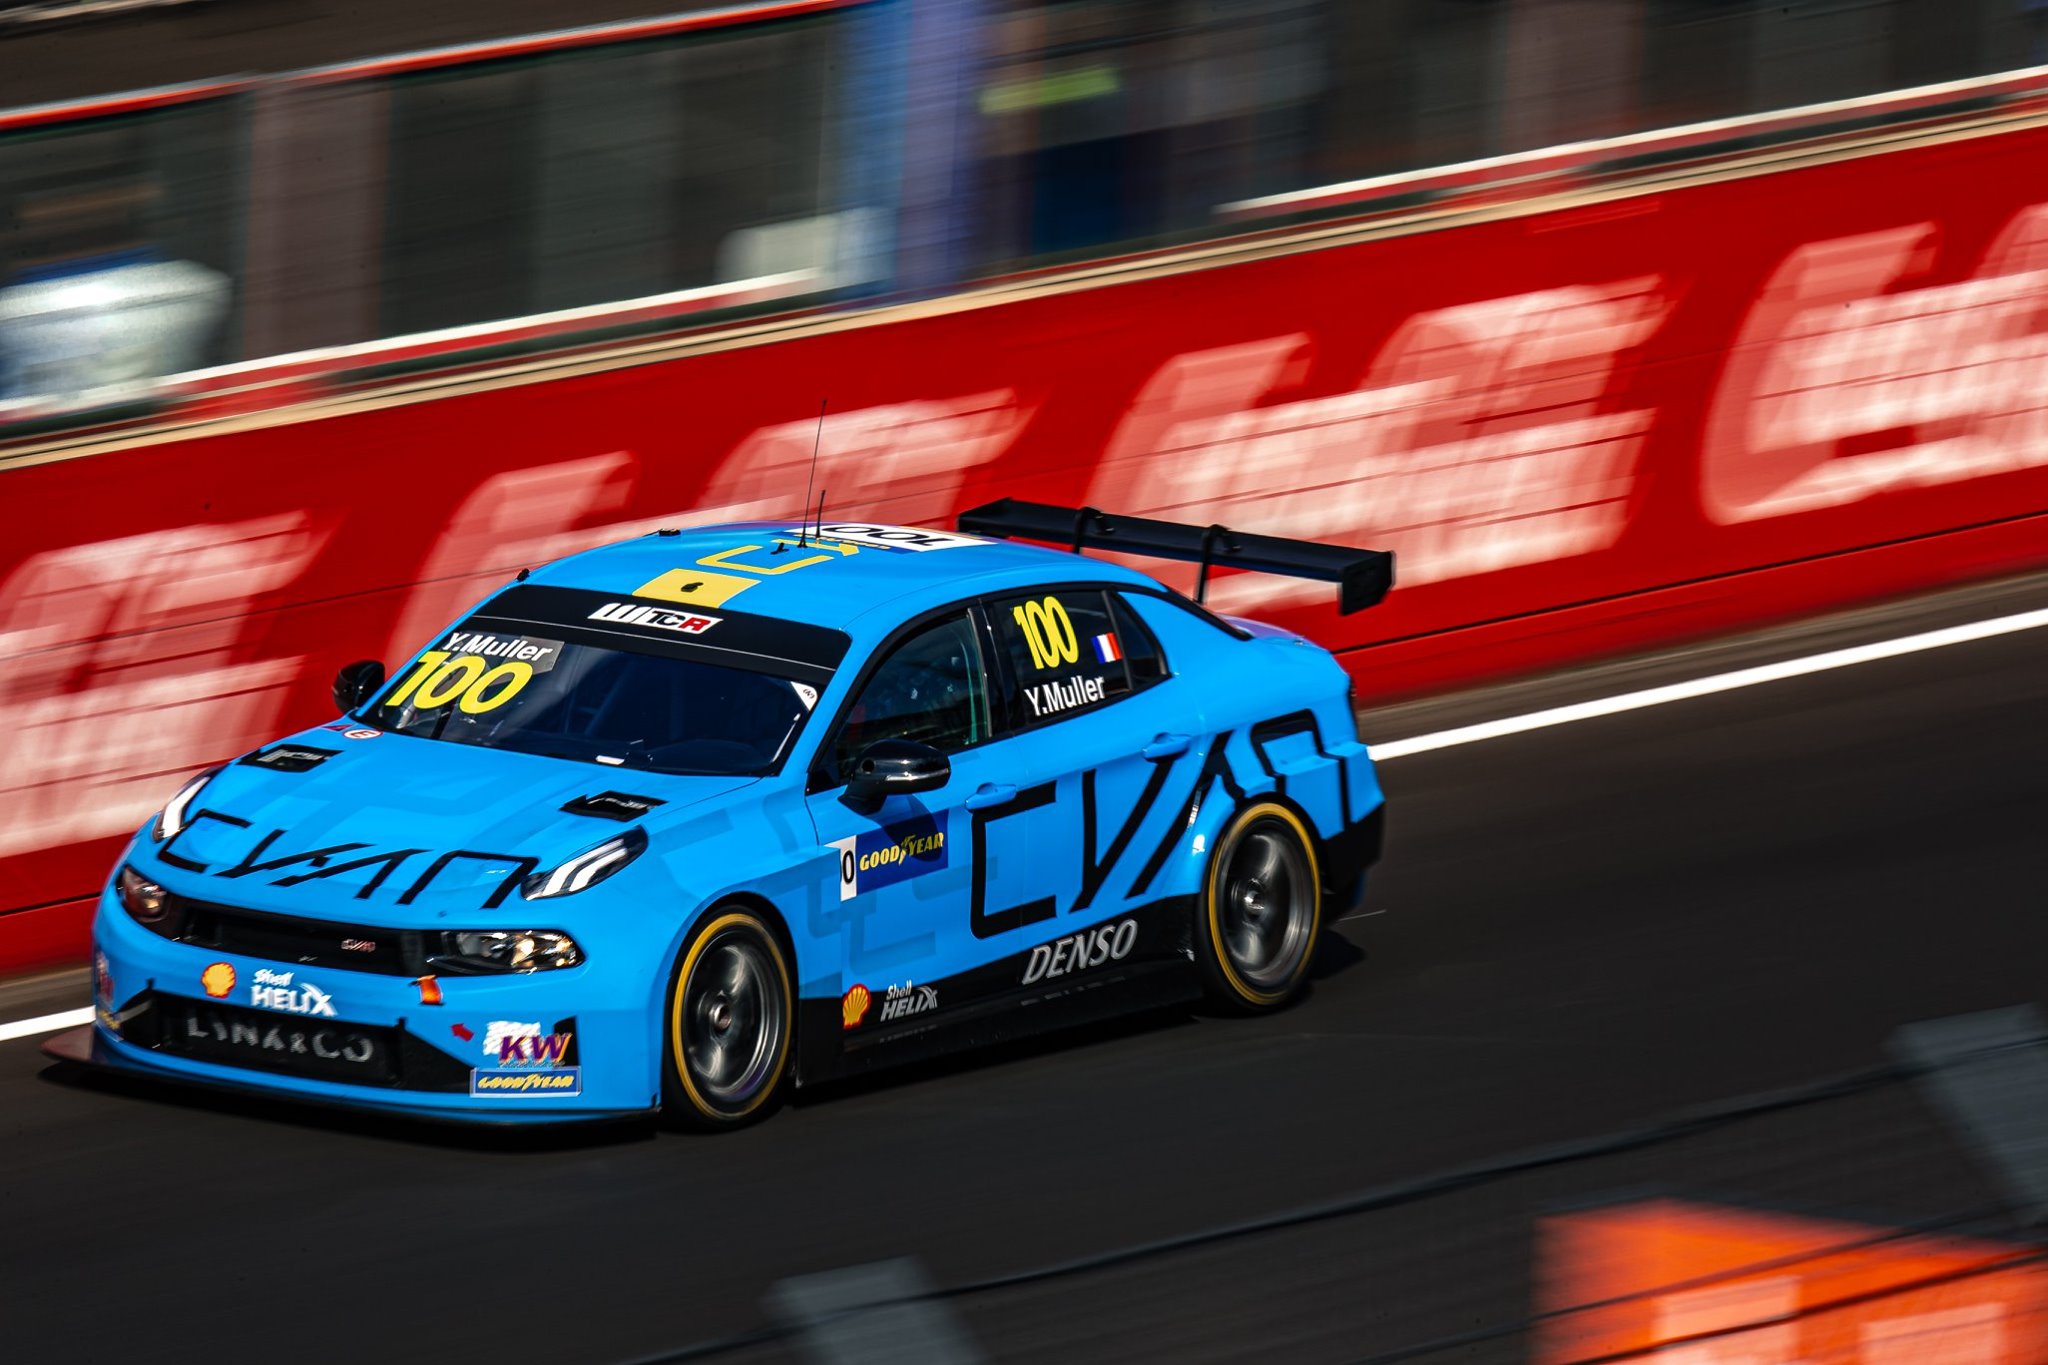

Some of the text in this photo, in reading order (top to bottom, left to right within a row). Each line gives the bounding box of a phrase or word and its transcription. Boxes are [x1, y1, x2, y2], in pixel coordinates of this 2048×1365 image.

[588, 603, 723, 634] WTCR
[1013, 596, 1079, 669] 100
[442, 633, 553, 661] Y.Muller
[385, 651, 533, 714] 100
[1024, 675, 1105, 716] Y.Muller
[860, 832, 944, 871] GOODYEAR
[1022, 920, 1138, 985] DENSO
[252, 969, 295, 987] Shell
[886, 979, 912, 1000] Shell
[250, 983, 339, 1017] HELIX
[880, 986, 938, 1022] HELIX
[499, 1033, 572, 1062] KW
